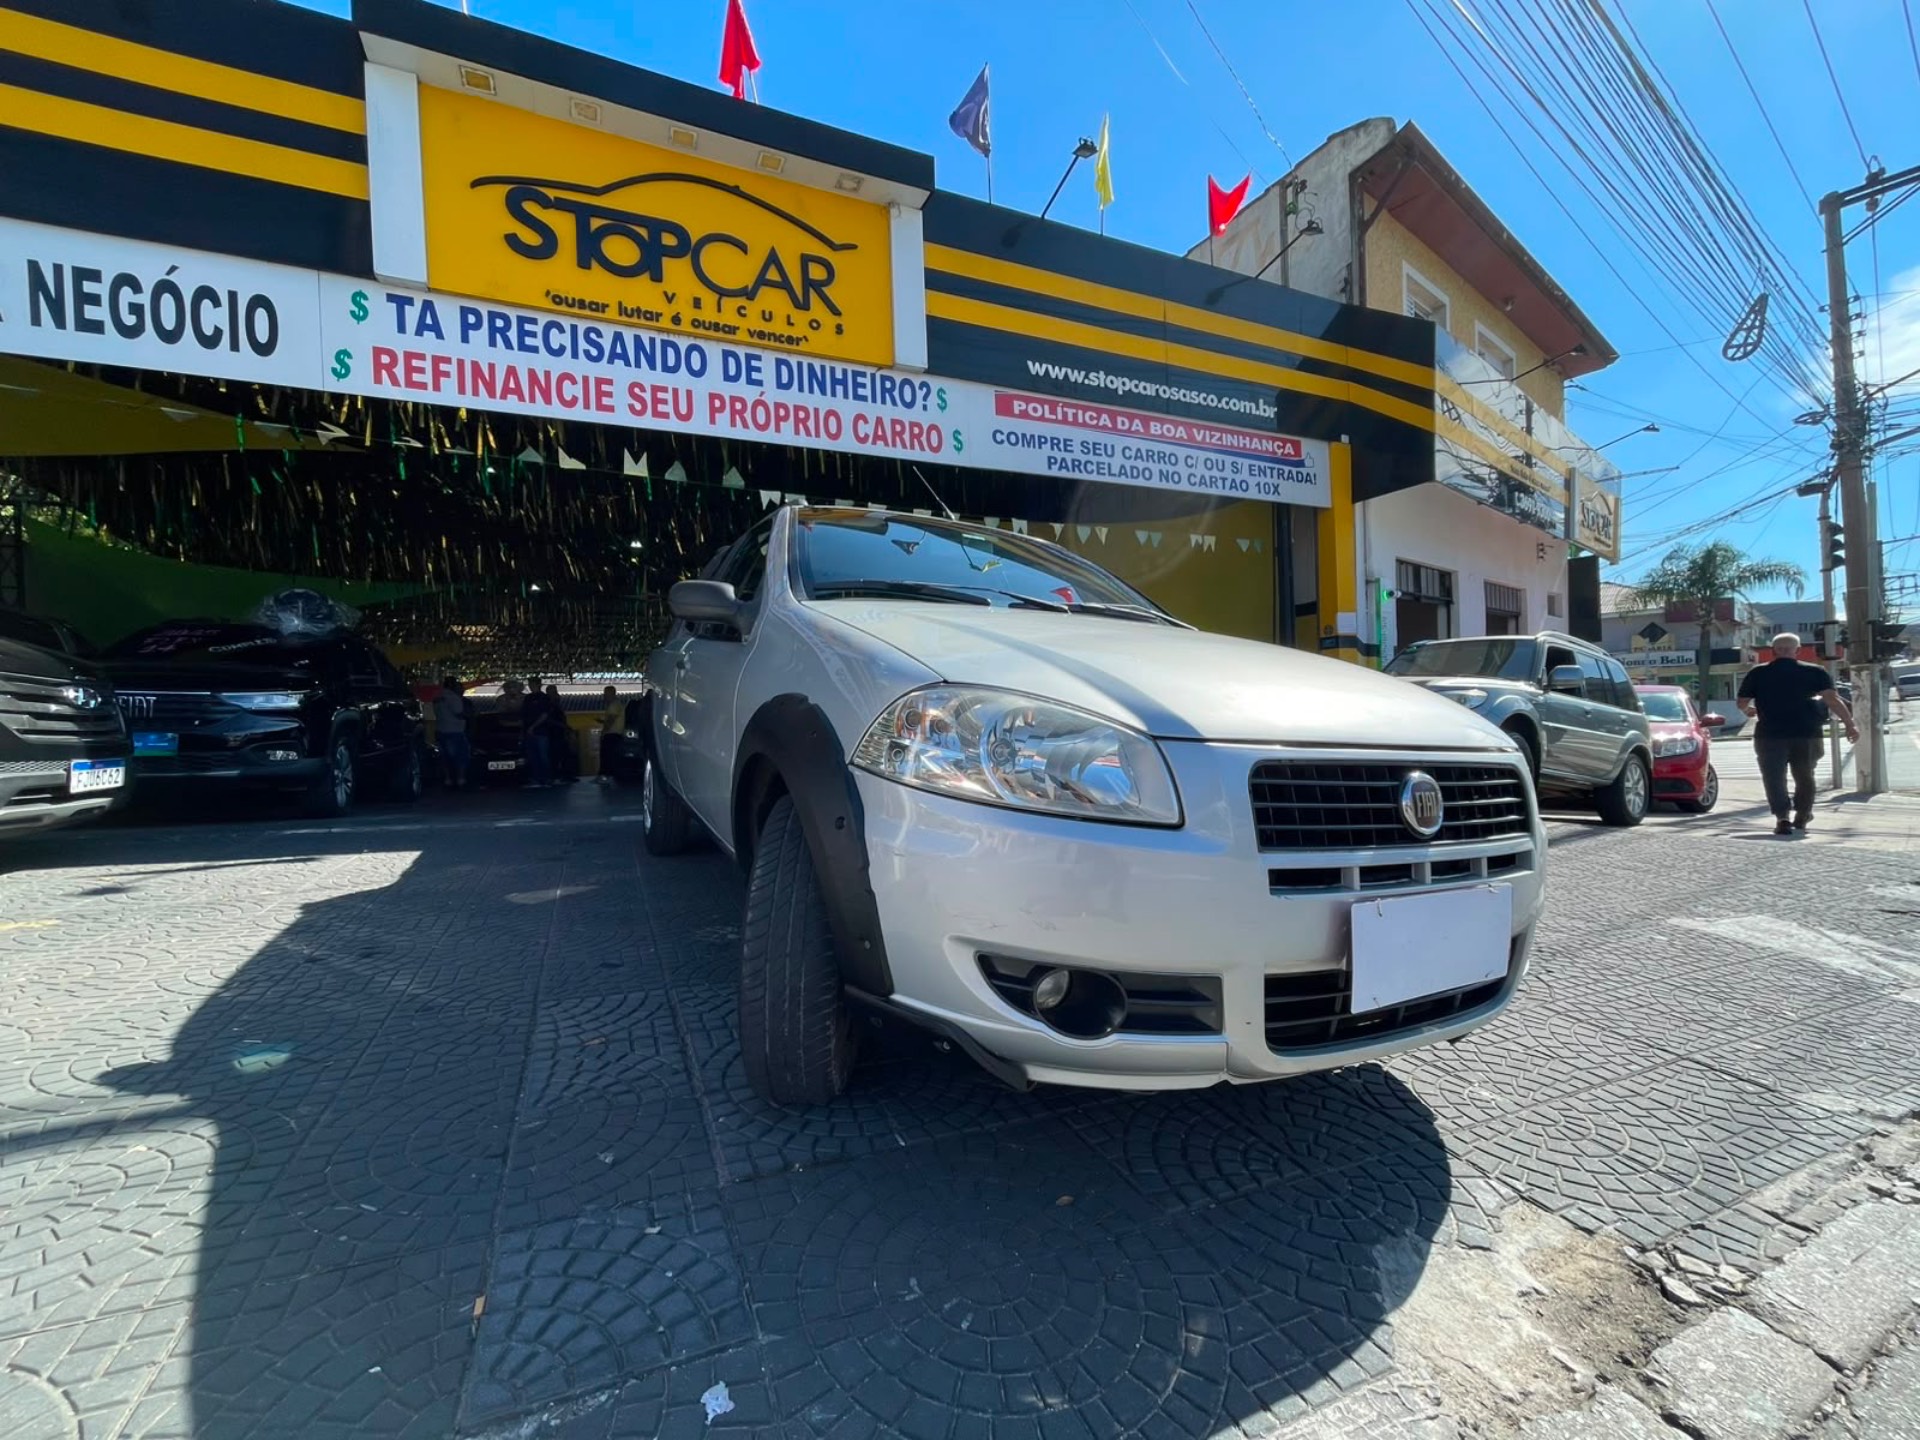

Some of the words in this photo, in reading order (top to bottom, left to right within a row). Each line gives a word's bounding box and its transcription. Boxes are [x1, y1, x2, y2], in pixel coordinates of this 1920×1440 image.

[26, 258, 279, 358] NEGÓCIO
[618, 301, 662, 323] lutar
[671, 310, 681, 326] é
[691, 316, 739, 337] ousar
[386, 292, 445, 341] TA
[459, 305, 707, 378] PRECISANDO
[721, 348, 764, 387] DE
[775, 357, 931, 412] DINHEIRO?
[372, 345, 616, 414] REFINANCIE
[627, 381, 693, 422] SEU
[708, 390, 842, 441] PRÓPRIO
[852, 412, 943, 454] CARRO
[1026, 358, 1278, 419] www.stopcarosasco.com.br
[1013, 399, 1112, 428] POLÍTICA
[1116, 415, 1144, 434] DA
[1150, 420, 1188, 440] BOA
[1193, 427, 1294, 457] VIZINHANÇA
[992, 429, 1073, 453] COMPRE
[1081, 440, 1115, 458] SEU
[1122, 445, 1178, 466] CARRO
[1184, 454, 1199, 470] C/
[1204, 457, 1226, 473] OU
[1231, 459, 1244, 475] S/
[1250, 463, 1317, 486] ENTRADA!
[1047, 455, 1153, 482] PARCELADO
[1159, 467, 1182, 485] NO
[1254, 480, 1281, 497] 10X
[1660, 655, 1693, 665] Bello
[1415, 792, 1437, 817] FIAT
